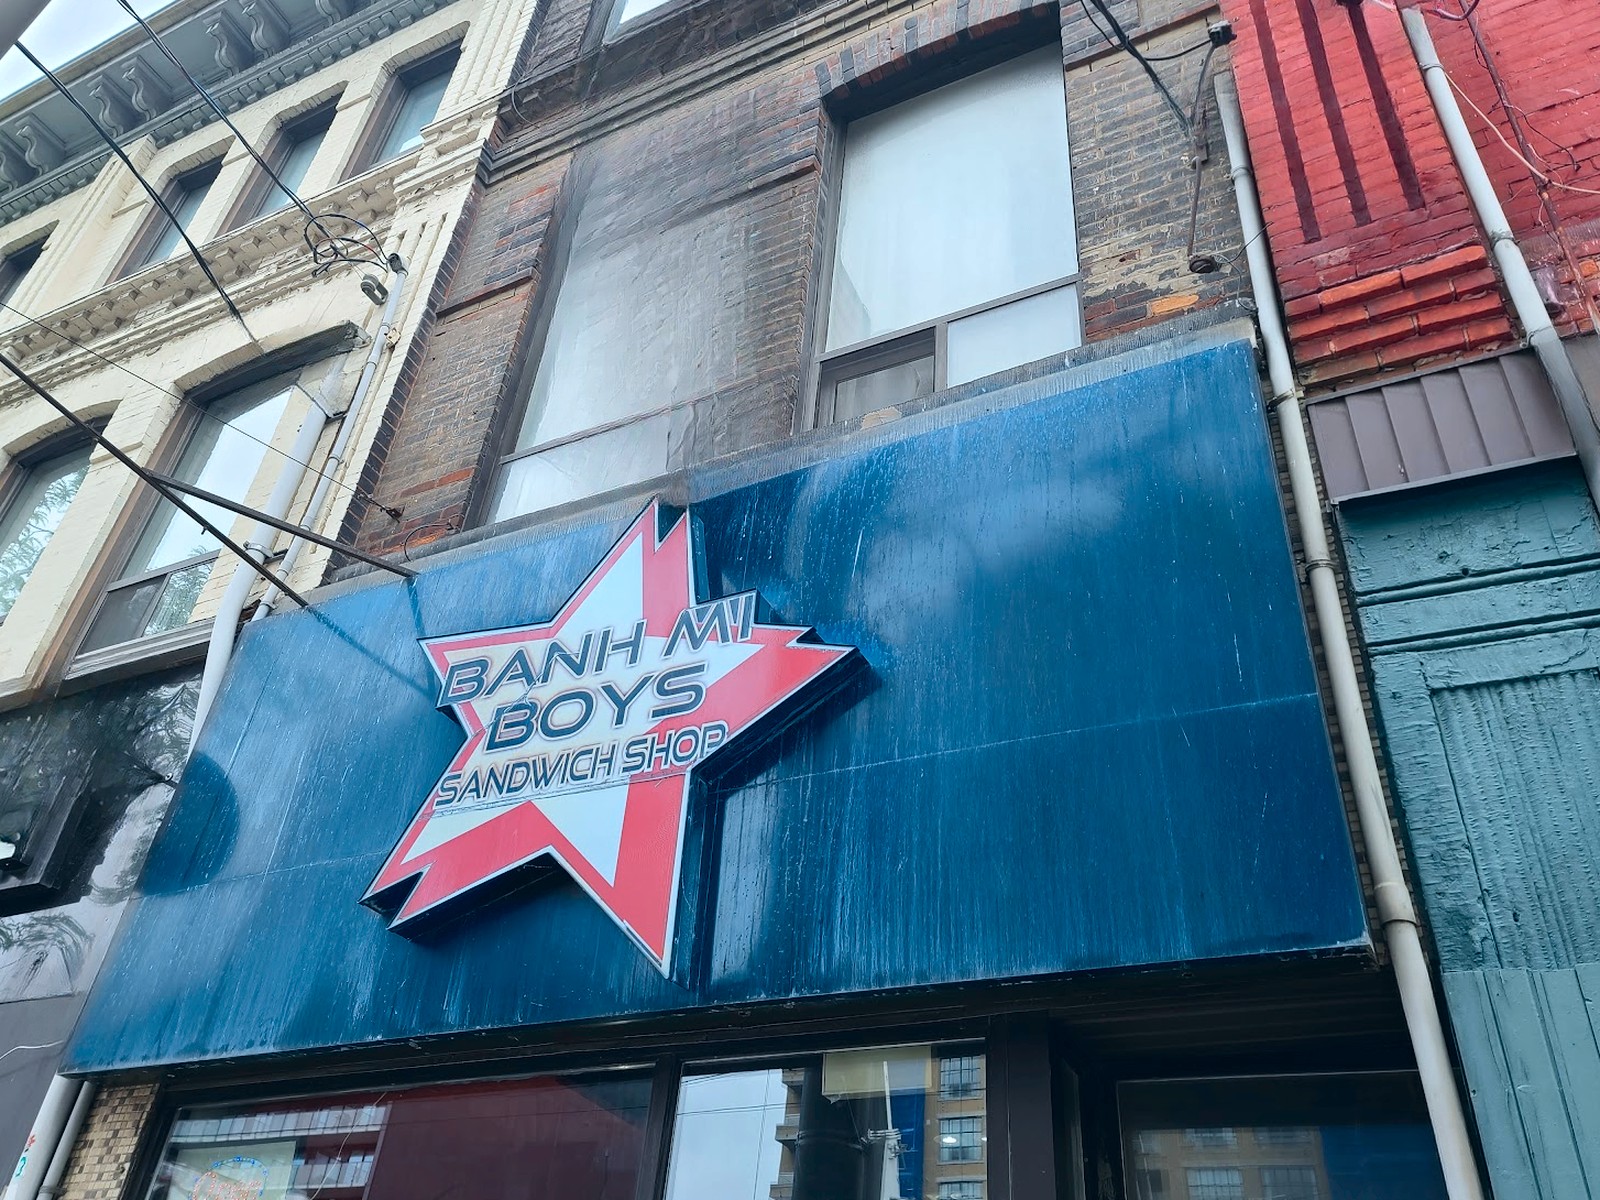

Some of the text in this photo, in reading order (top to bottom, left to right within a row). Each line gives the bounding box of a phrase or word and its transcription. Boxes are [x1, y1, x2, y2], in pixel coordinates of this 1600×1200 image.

[437, 594, 755, 707] BANH MI
[485, 662, 707, 752] BOYS
[434, 721, 727, 808] SANDWICH SHOP
